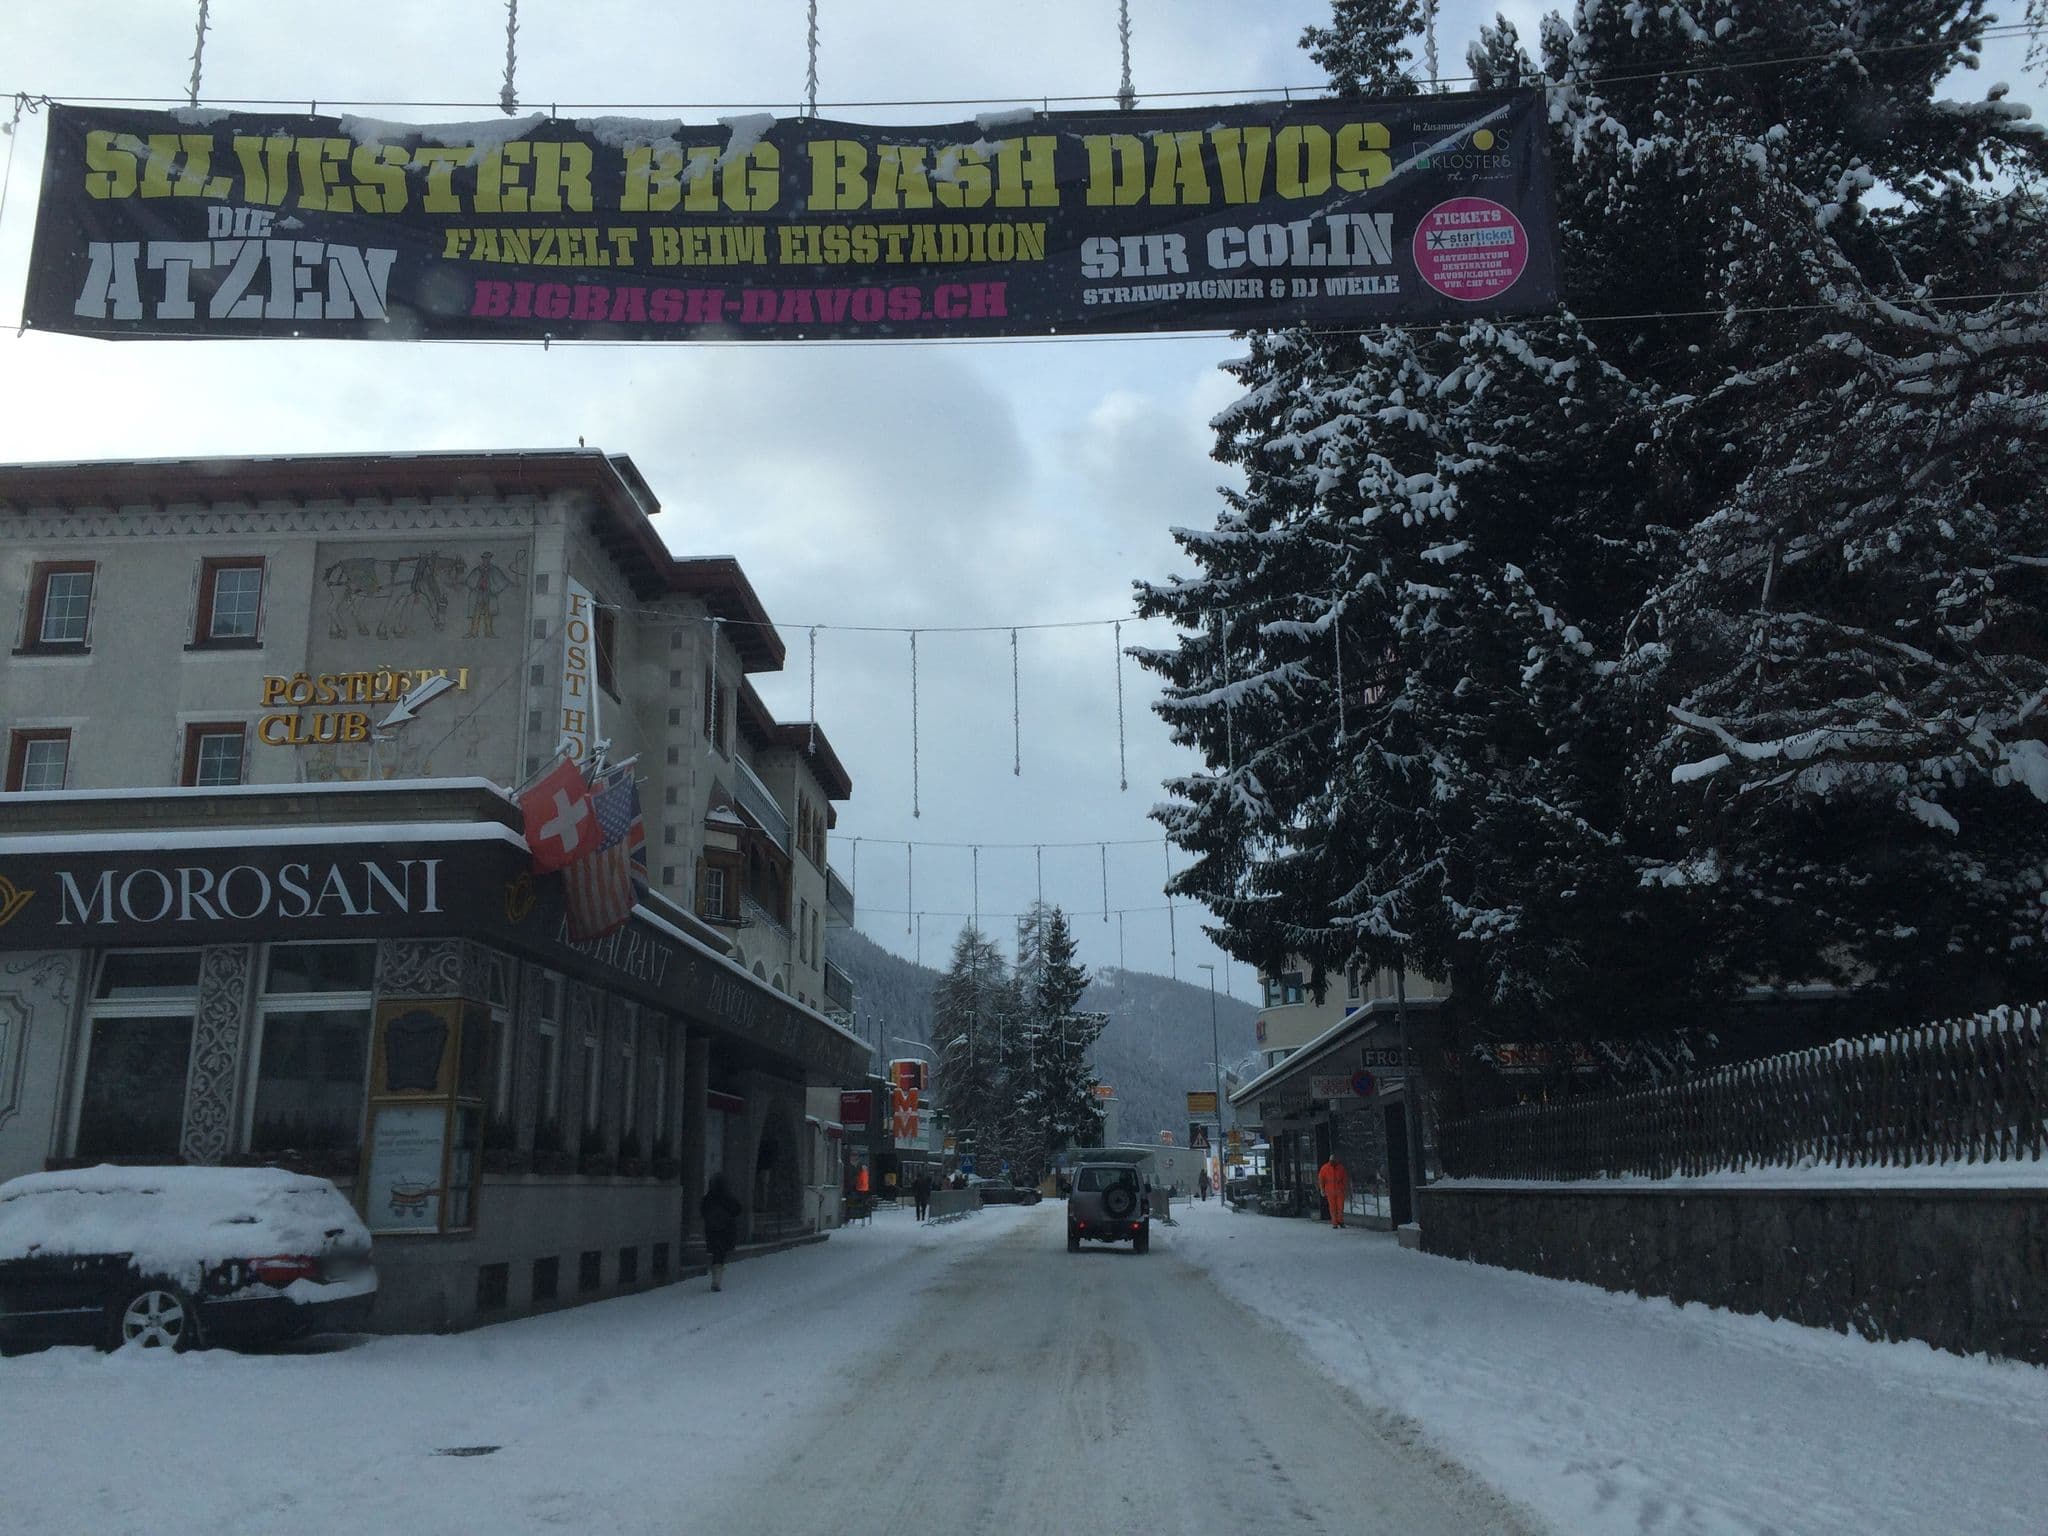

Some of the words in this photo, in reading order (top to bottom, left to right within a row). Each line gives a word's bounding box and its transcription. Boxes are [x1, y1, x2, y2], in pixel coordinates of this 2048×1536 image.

[1412, 128, 1511, 160] DVOS
[1432, 154, 1512, 169] KLOSTERS
[86, 130, 594, 213] SILVESTER
[619, 141, 781, 212] BIG
[807, 135, 1060, 209] BASH
[1083, 121, 1392, 206] DAVOS
[207, 205, 277, 238] DIE
[1433, 210, 1502, 226] TICKETS
[442, 226, 638, 266] FANZELT
[649, 225, 768, 266] BEIM
[778, 222, 1047, 265] EISSTADION
[1080, 232, 1190, 279] SIR
[1206, 212, 1395, 271] COLIN
[1450, 229, 1513, 243] starticket
[74, 239, 398, 320] ATZEN
[1442, 260, 1503, 271] DESTINATION
[469, 281, 1008, 324] BIGBASH-DAVOS.CH
[1082, 277, 1265, 305] STRAMPAGNER
[1269, 278, 1286, 298] &
[1291, 278, 1319, 298] DJ
[260, 670, 404, 707] PÖSTLI
[257, 711, 372, 746] CLUB
[55, 859, 444, 926] MOROSANI
